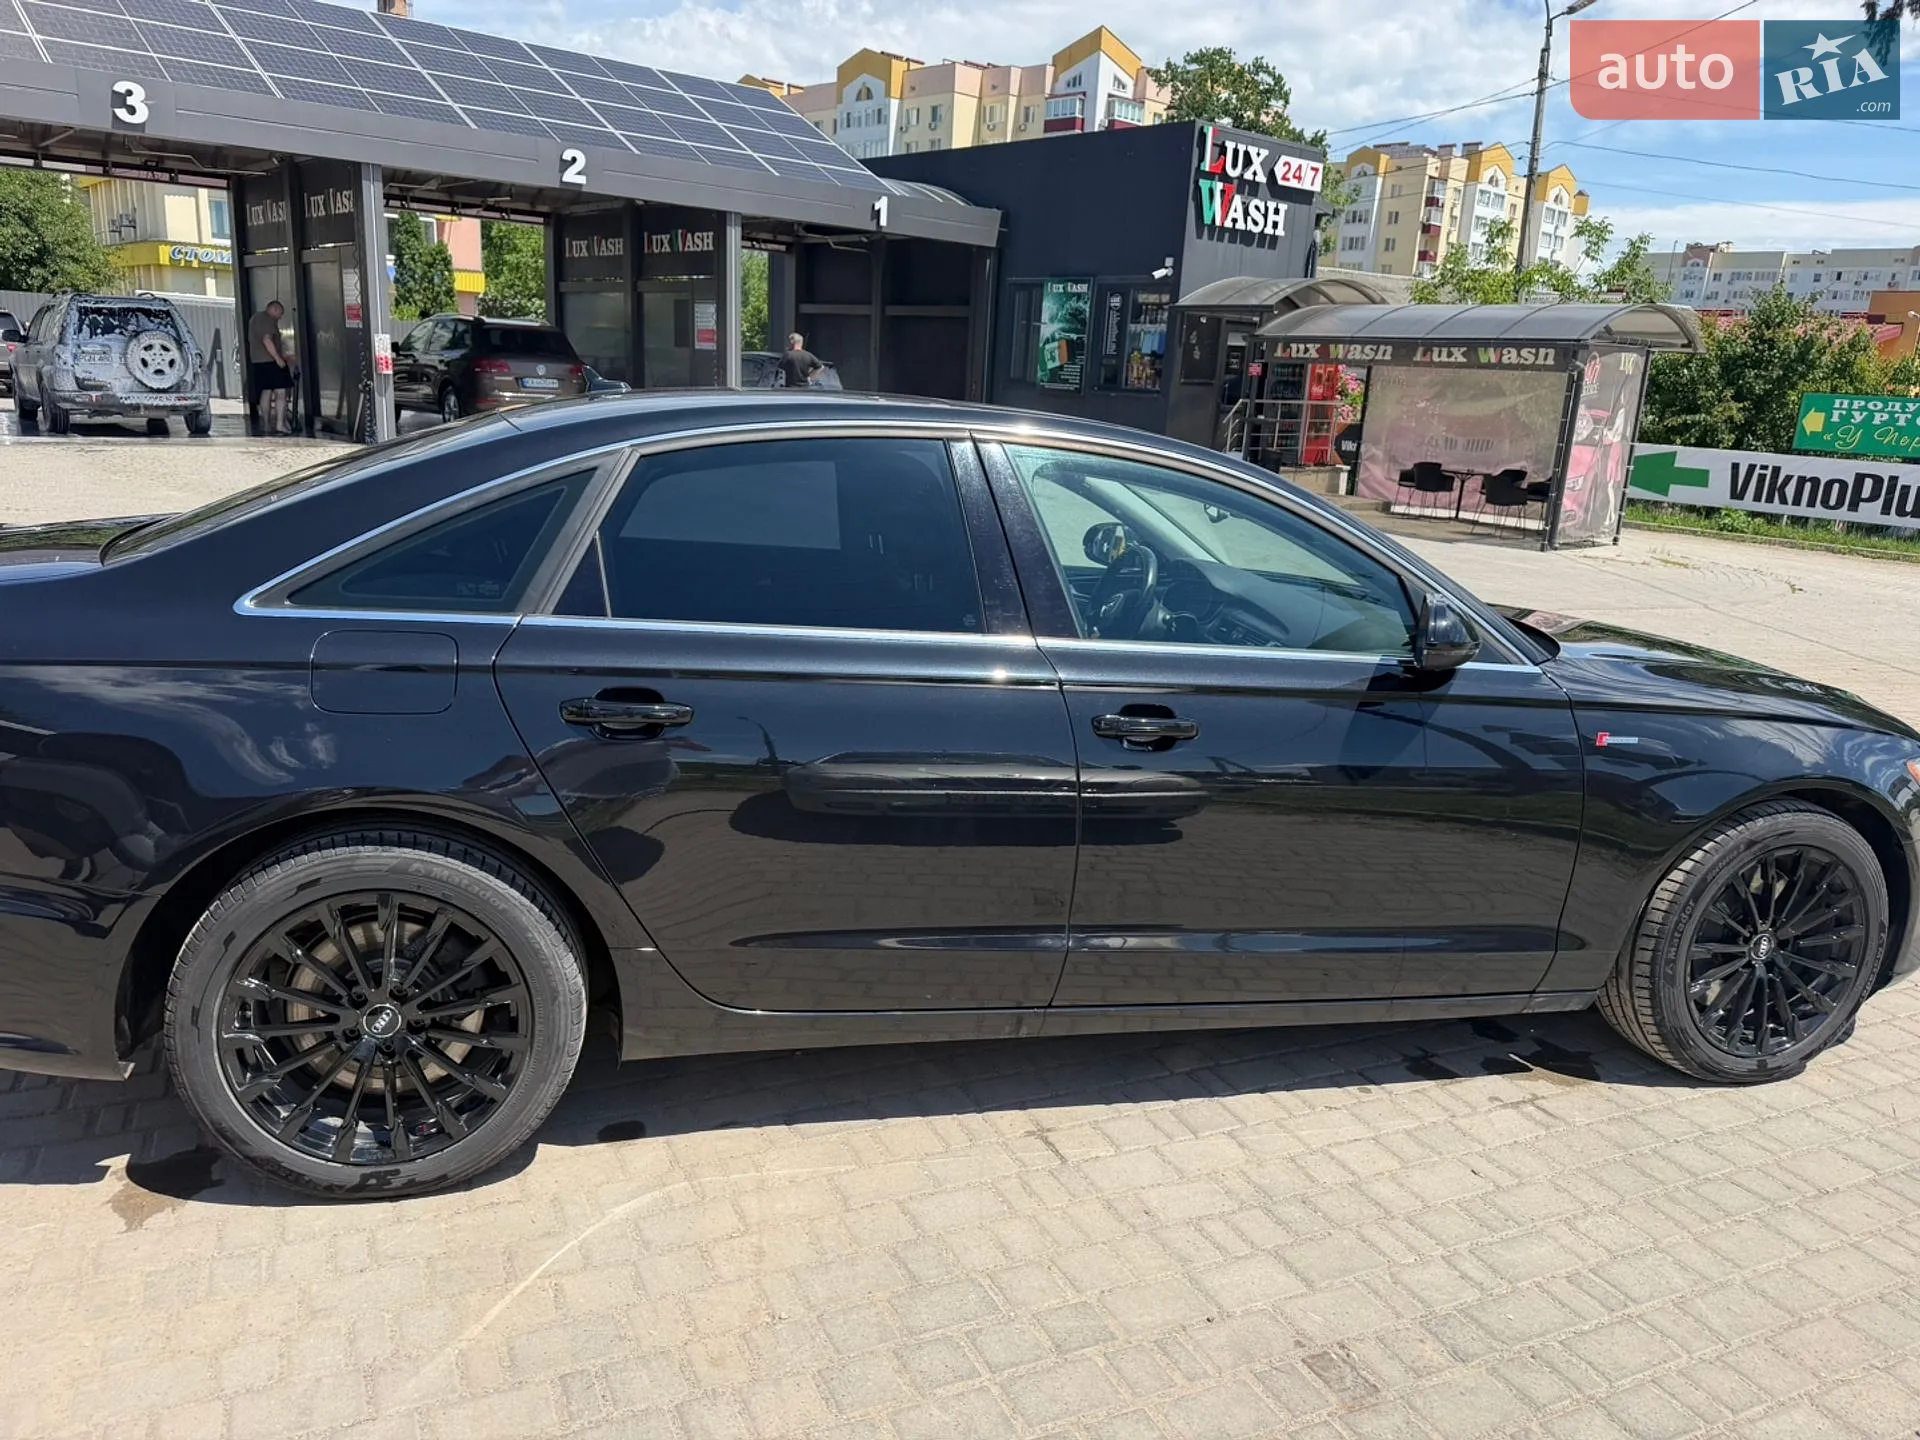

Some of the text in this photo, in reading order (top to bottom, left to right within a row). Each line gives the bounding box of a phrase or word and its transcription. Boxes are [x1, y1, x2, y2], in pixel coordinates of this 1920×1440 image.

[112, 81, 149, 124] 3
[561, 148, 587, 184] 2
[1200, 125, 1269, 183] LUX
[1281, 161, 1320, 188] 24/7
[871, 196, 888, 227] 1
[1199, 178, 1288, 236] WASH
[644, 229, 714, 254] LUX WASH
[1729, 462, 1920, 519] ViknoPlu
